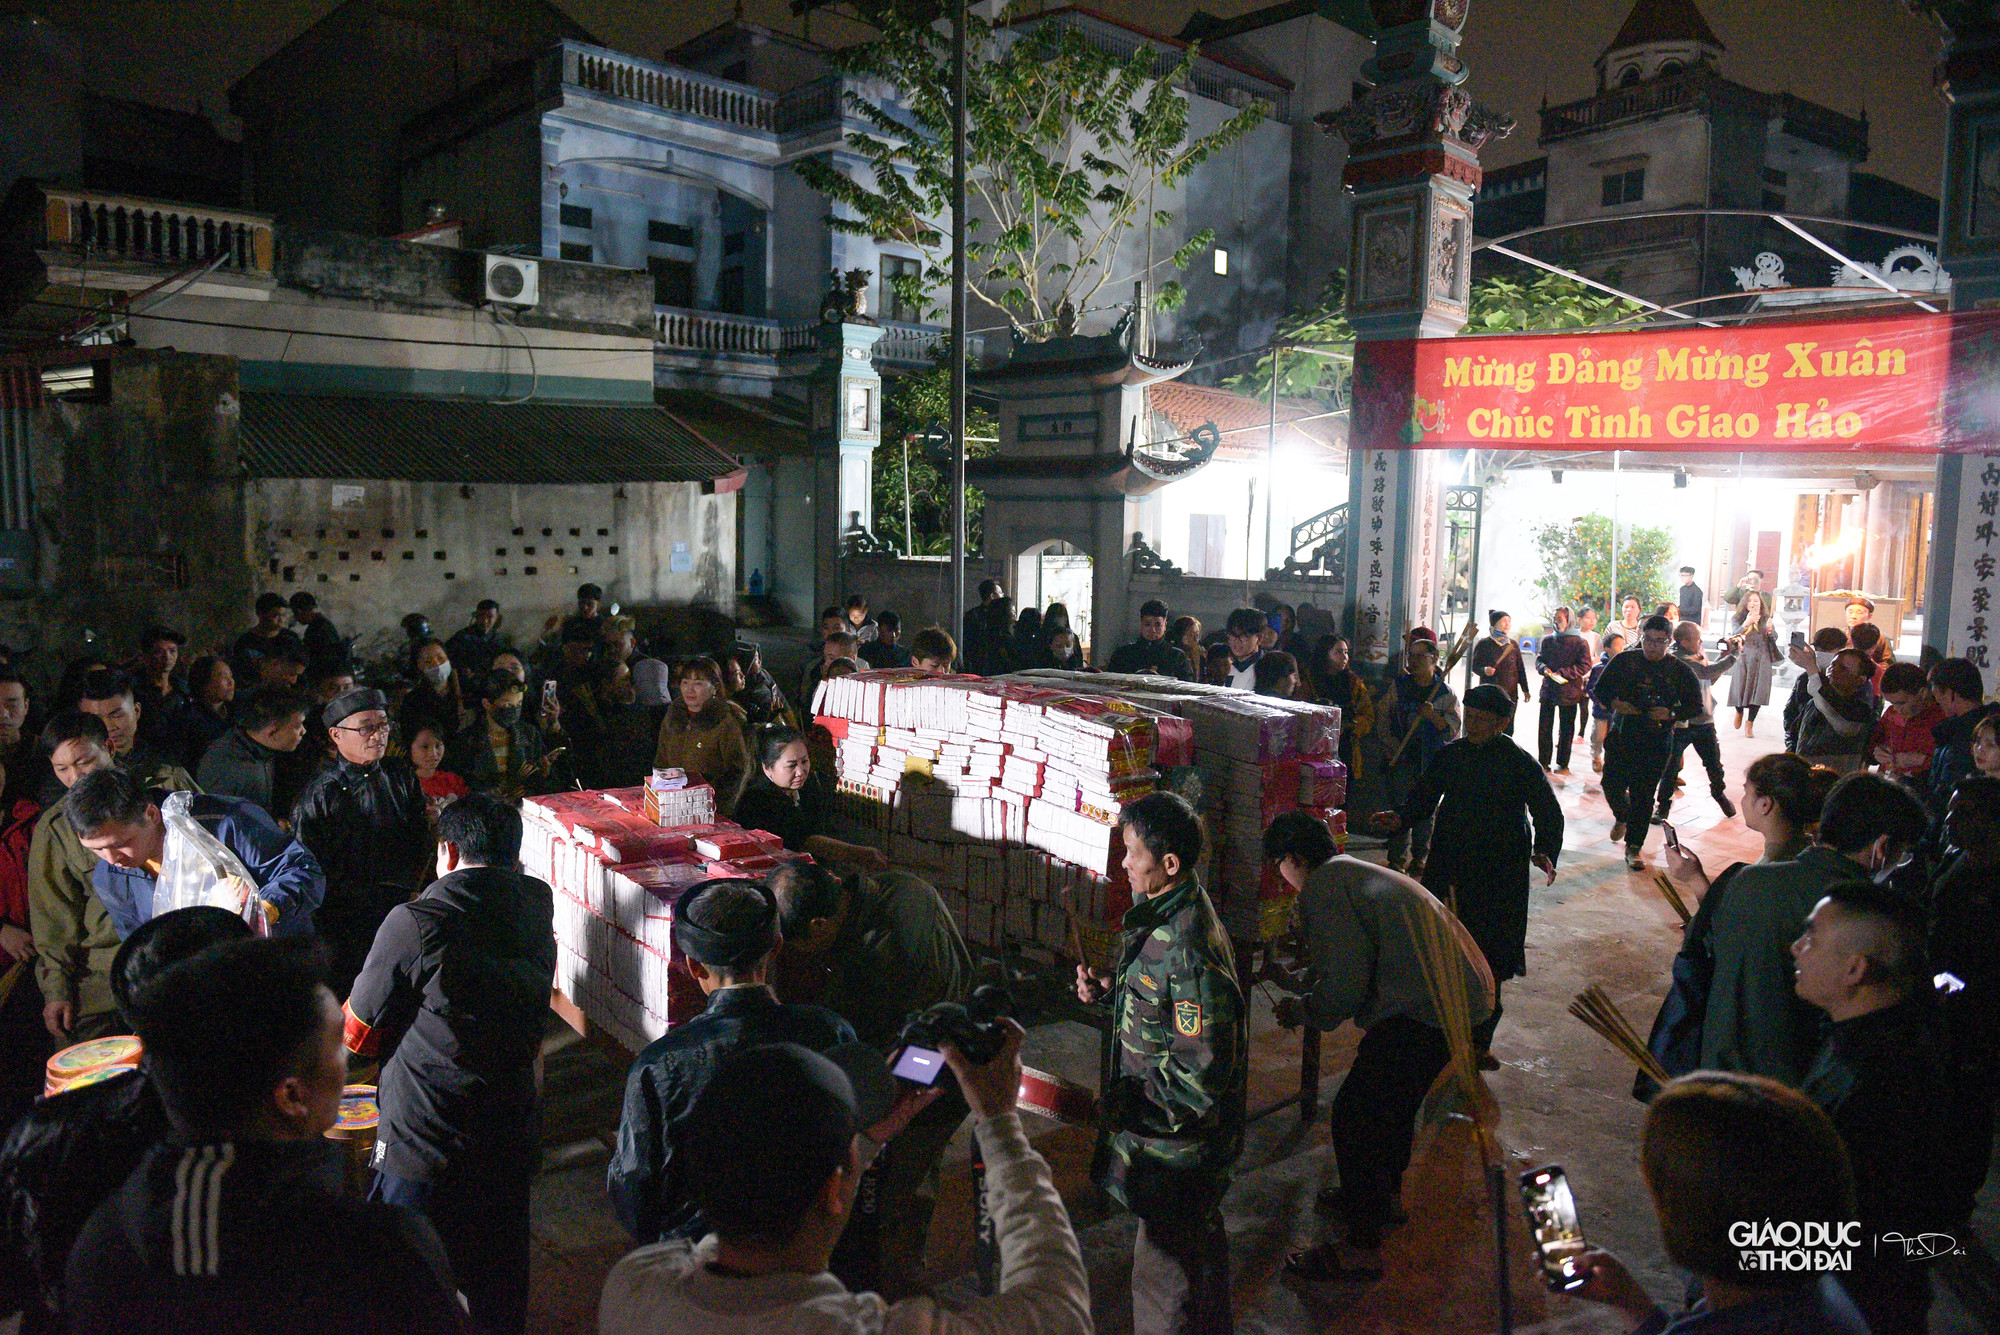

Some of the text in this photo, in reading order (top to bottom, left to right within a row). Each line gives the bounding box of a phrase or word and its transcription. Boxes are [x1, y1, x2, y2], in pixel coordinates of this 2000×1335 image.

[1443, 338, 1907, 394] Mừng Đảng Mừng Xuân
[1467, 397, 1863, 438] Chúc Tình Giao Hảo
